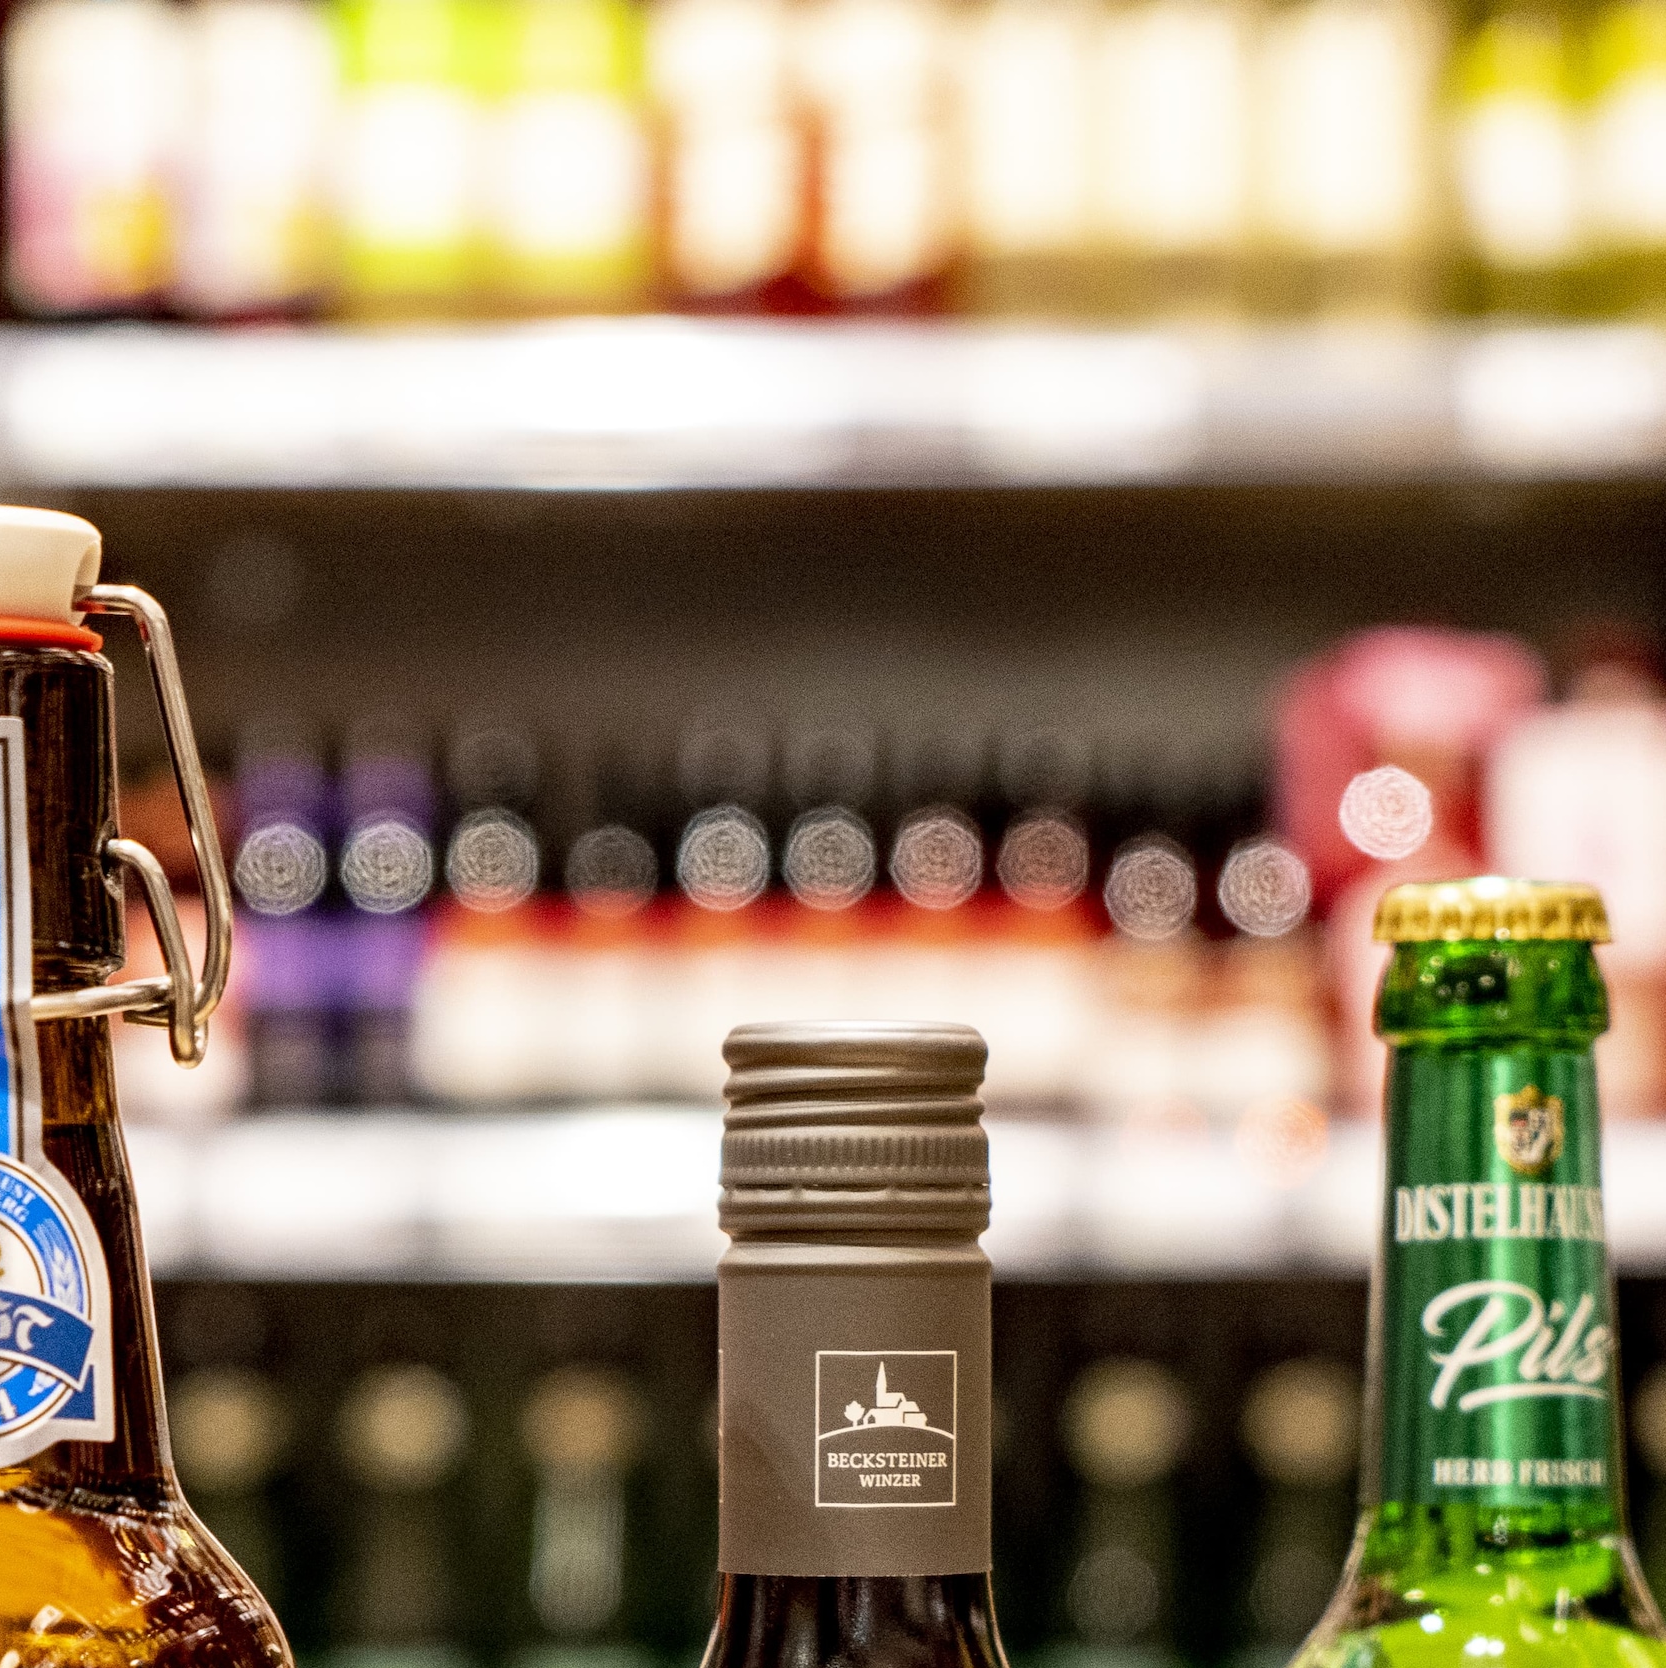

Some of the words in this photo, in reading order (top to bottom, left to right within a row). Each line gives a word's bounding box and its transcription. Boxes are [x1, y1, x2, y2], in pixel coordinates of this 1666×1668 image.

[1396, 1182, 1606, 1242] DISTELHÄUS
[1422, 1280, 1614, 1410] Pils
[827, 1452, 948, 1470] BECKSTEINER
[1433, 1458, 1513, 1486] HERB
[1518, 1458, 1605, 1486] FRISCH
[859, 1473, 922, 1488] WINZER
